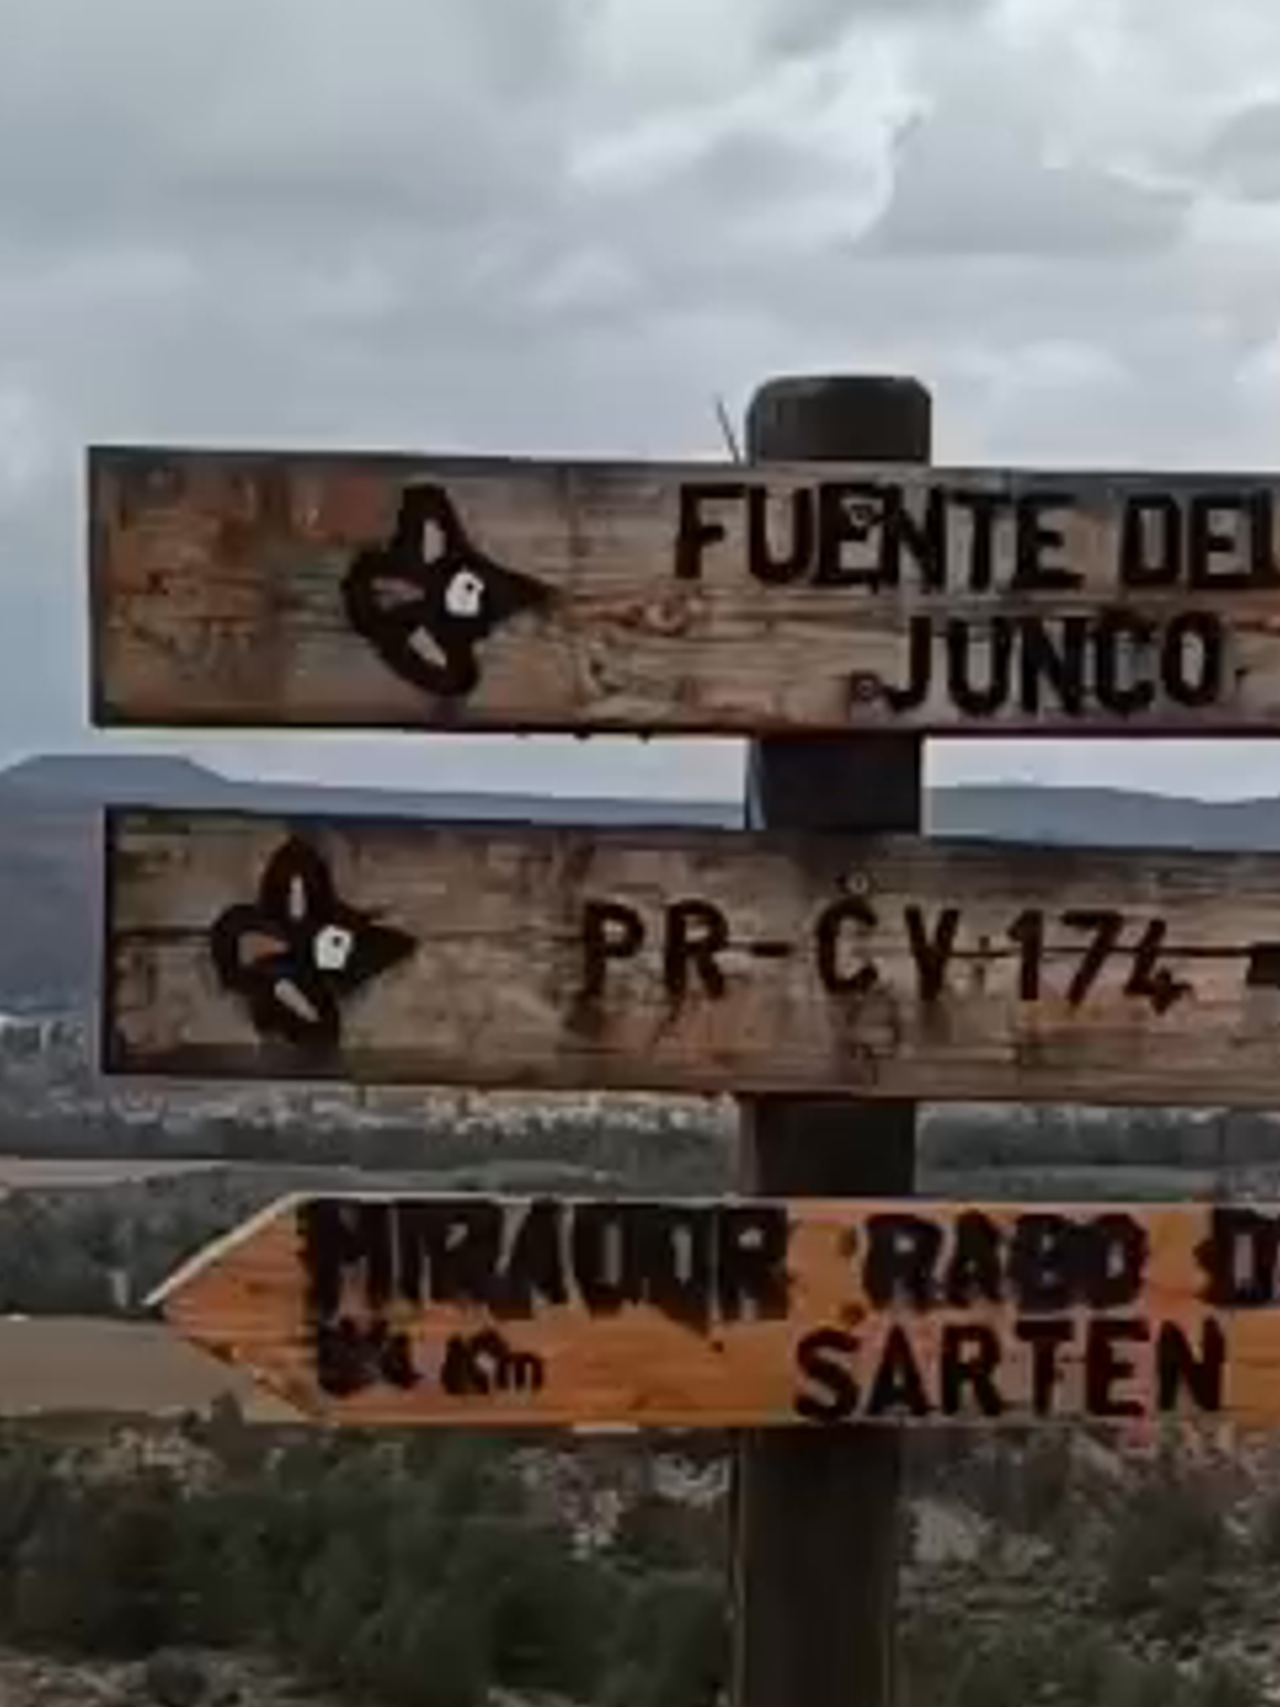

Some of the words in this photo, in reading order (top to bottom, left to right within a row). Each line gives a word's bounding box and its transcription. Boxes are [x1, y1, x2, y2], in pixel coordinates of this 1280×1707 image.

[674, 481, 1083, 591] FUENTE
[880, 609, 1225, 717] JUNCO
[300, 1201, 789, 1331] MIRADOR
[862, 1211, 1148, 1311] RABO
[792, 1315, 1227, 1421] SARTEN
